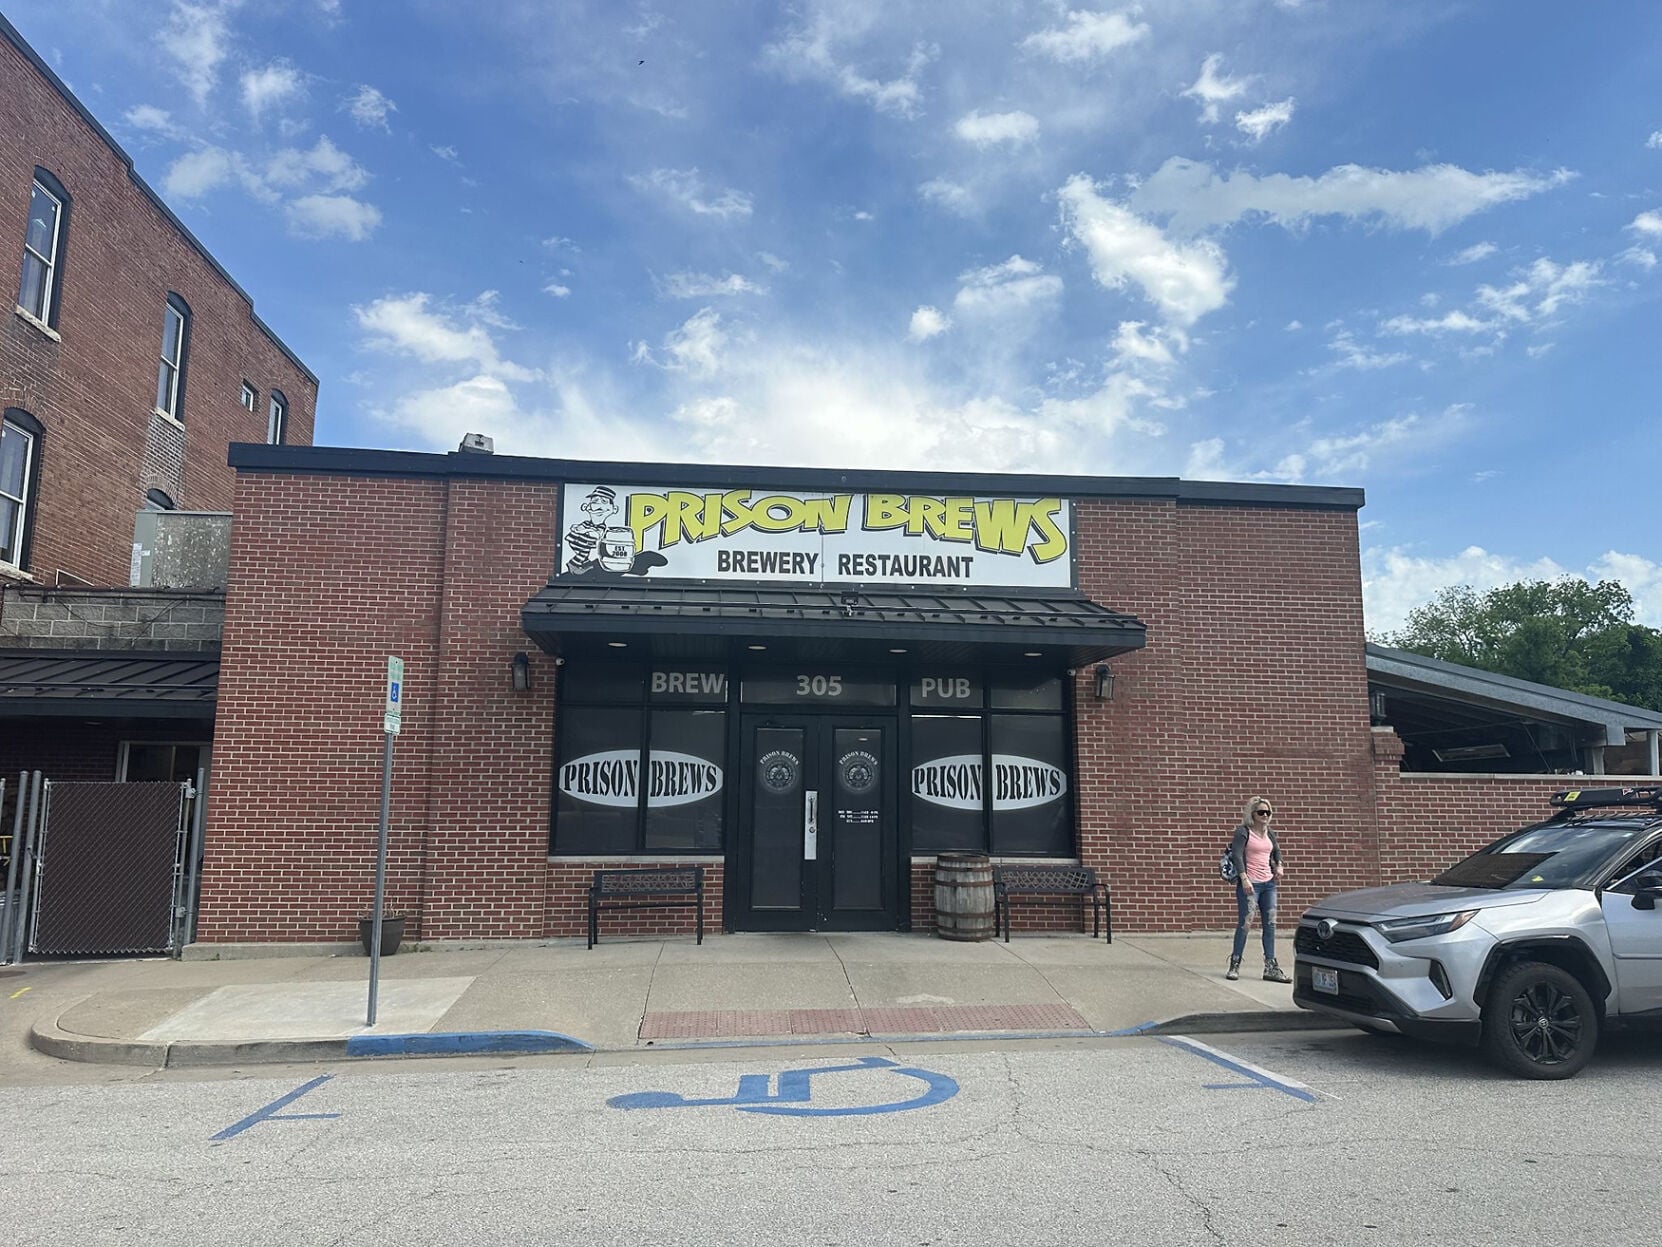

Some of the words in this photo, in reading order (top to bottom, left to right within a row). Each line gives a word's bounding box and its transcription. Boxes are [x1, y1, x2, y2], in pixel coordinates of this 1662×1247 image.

[626, 489, 853, 554] PRISON
[861, 493, 1067, 564] BREWS
[718, 550, 818, 575] BREWERY
[838, 553, 973, 578] RESTAURANT
[651, 672, 725, 694] BREW
[796, 675, 843, 696] 305
[921, 677, 971, 698] PUB
[564, 760, 638, 797] PRISON
[650, 760, 717, 797] BREWS
[914, 764, 982, 800] PRISON
[995, 764, 1061, 801] BREWS
